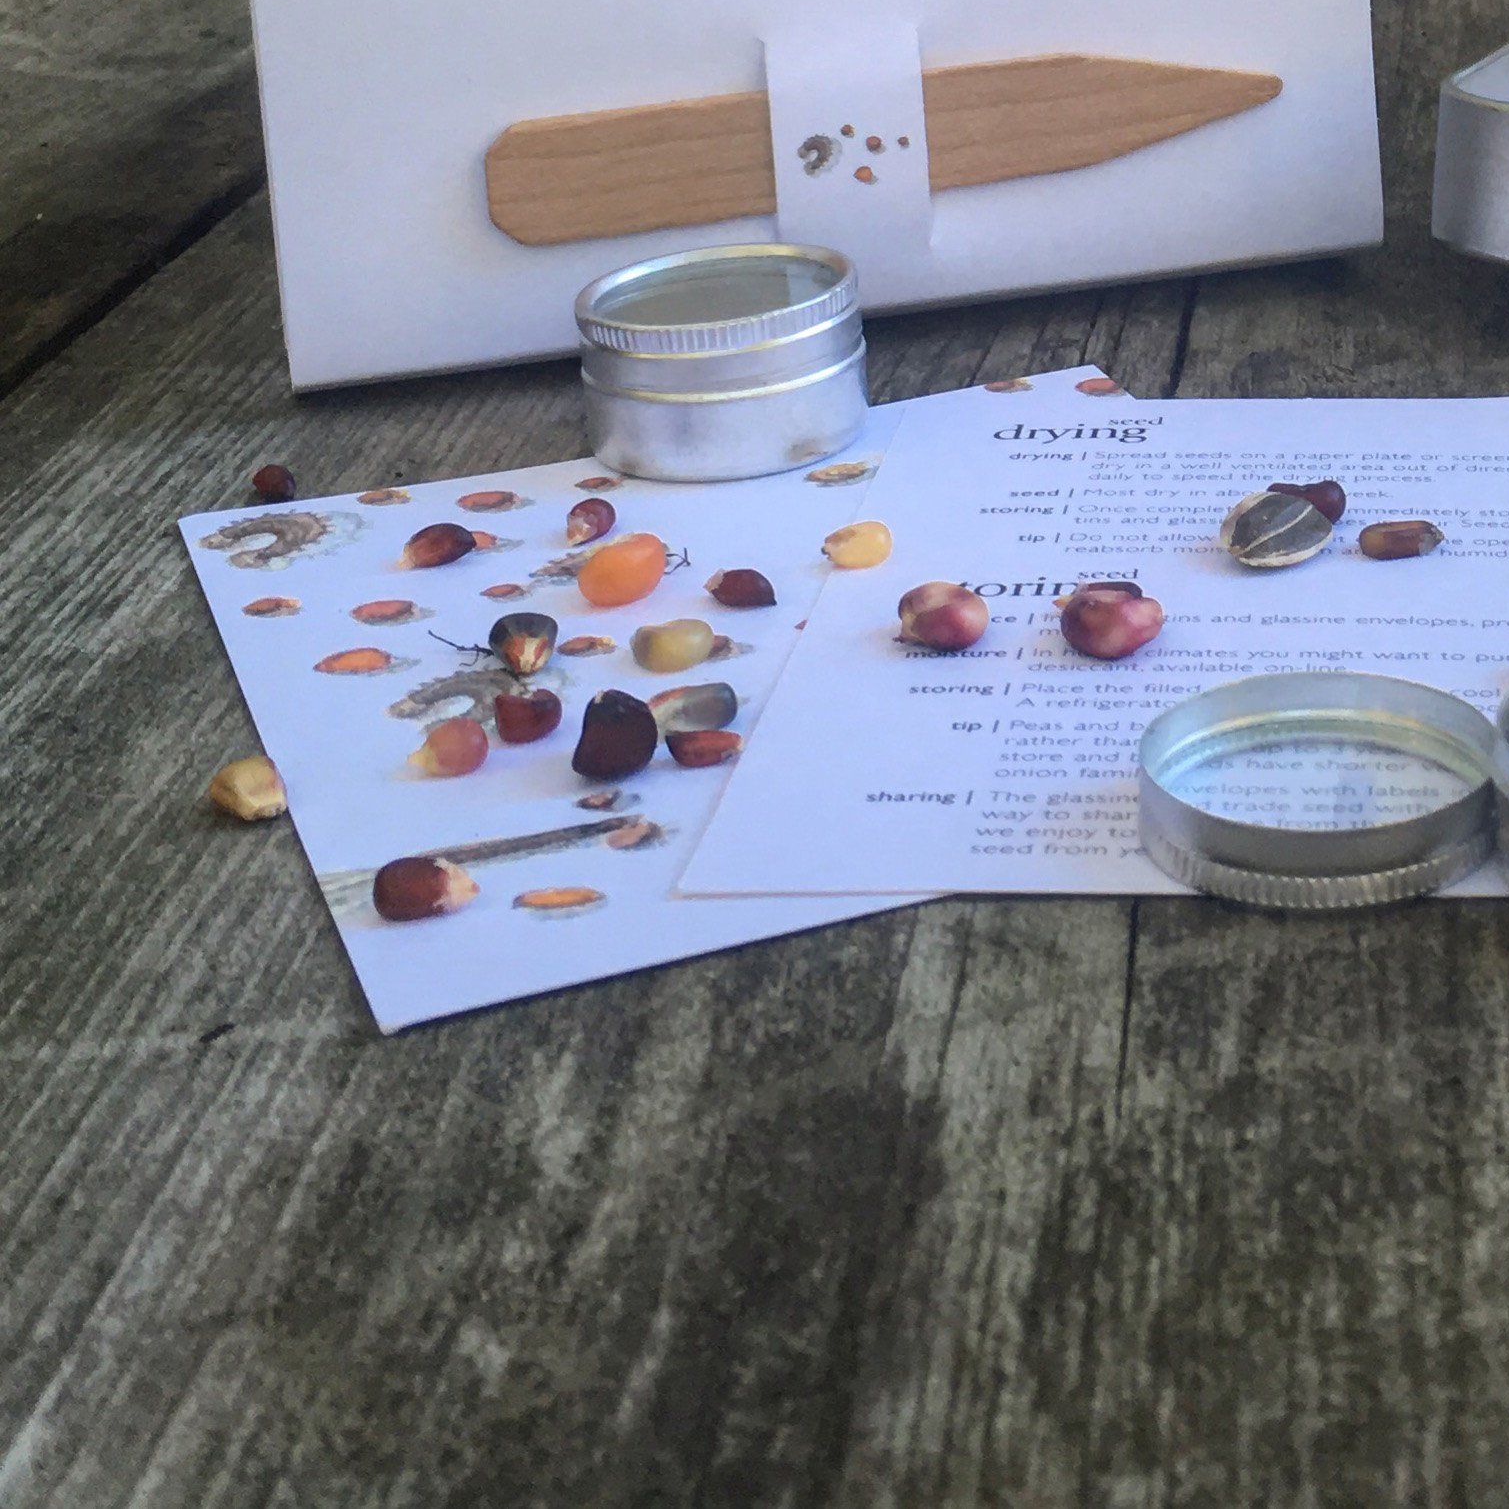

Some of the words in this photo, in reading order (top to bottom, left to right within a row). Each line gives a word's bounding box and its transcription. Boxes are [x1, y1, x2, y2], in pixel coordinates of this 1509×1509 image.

[1109, 417, 1164, 426] seed
[993, 424, 1150, 444] drying
[1009, 449, 1074, 460] drying
[1010, 487, 1060, 496] seed
[979, 504, 1054, 515] storing
[1018, 533, 1046, 543] tip
[1078, 569, 1139, 579] seed
[909, 685, 994, 697] storing
[952, 721, 982, 734] tip
[866, 792, 956, 806] sharing
